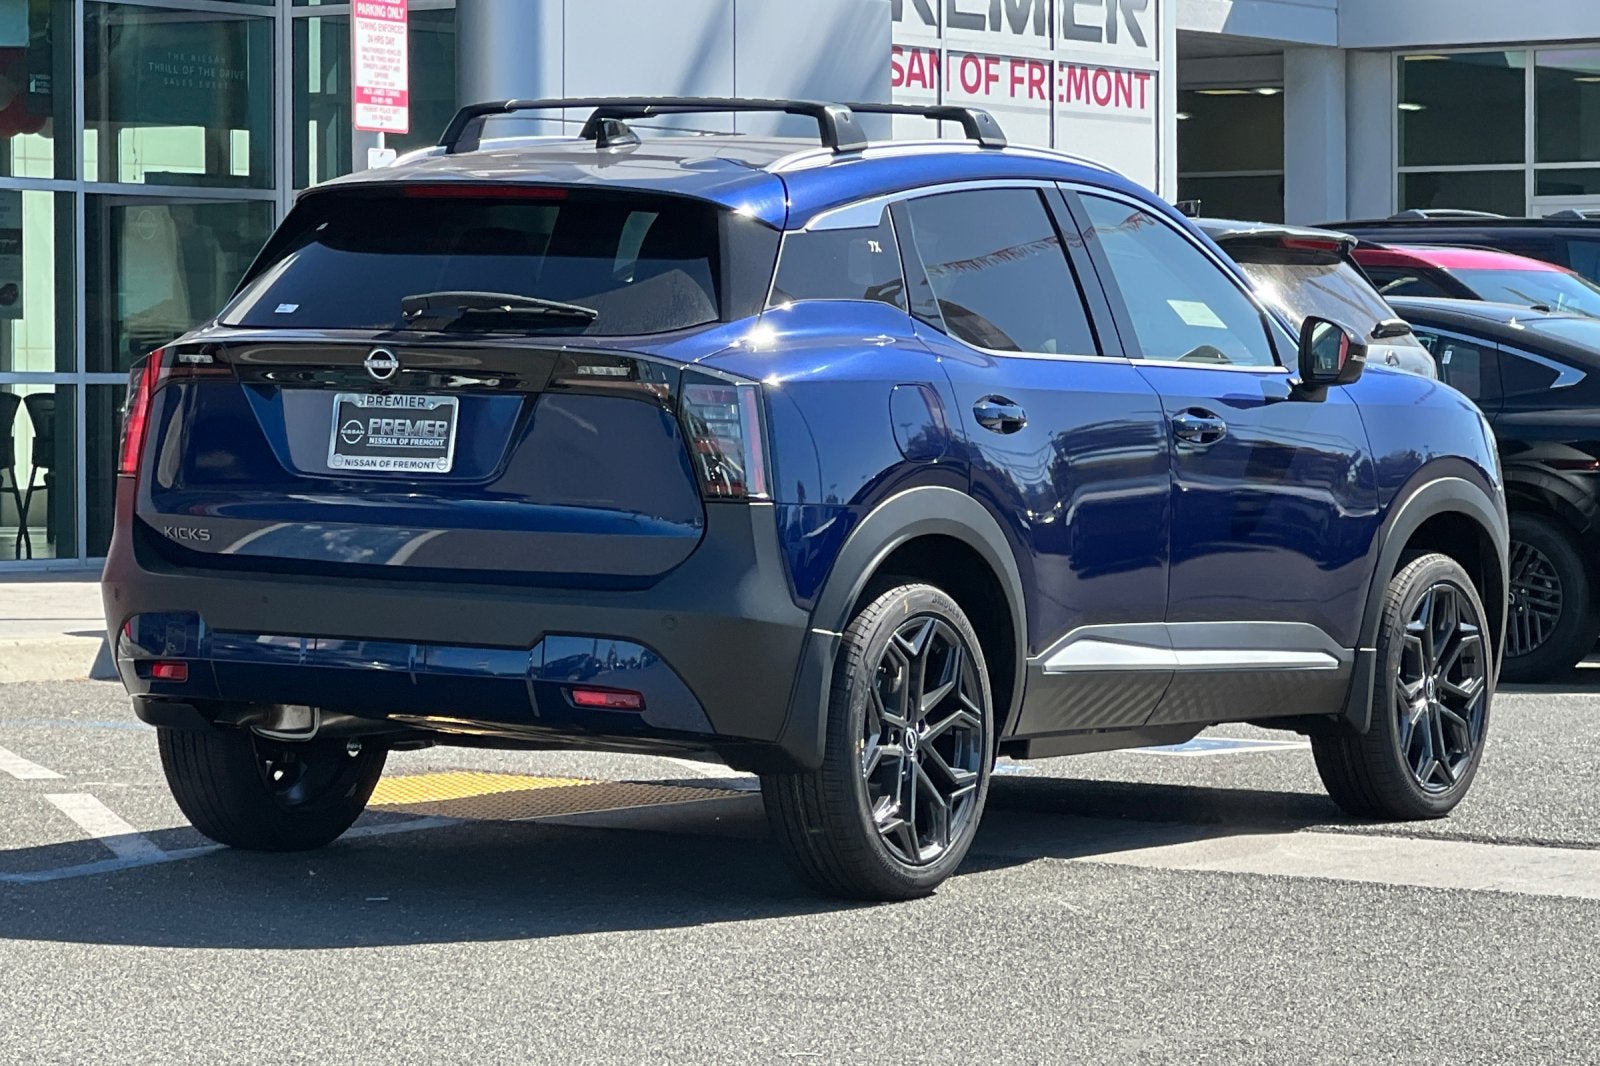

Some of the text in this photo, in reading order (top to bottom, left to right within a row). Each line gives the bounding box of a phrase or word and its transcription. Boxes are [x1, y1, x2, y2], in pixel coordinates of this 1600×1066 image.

[357, 2, 404, 19] PARKING ONLY
[149, 62, 245, 80] THRILL OF THE DRIVE
[960, 53, 1000, 95] OF
[366, 396, 426, 408] PREMIER
[368, 418, 448, 438] PREMIER
[369, 437, 397, 445] NISSAN
[344, 459, 377, 467] NISSAN
[393, 461, 435, 469] FREMONT
[163, 526, 210, 541] KICKS
